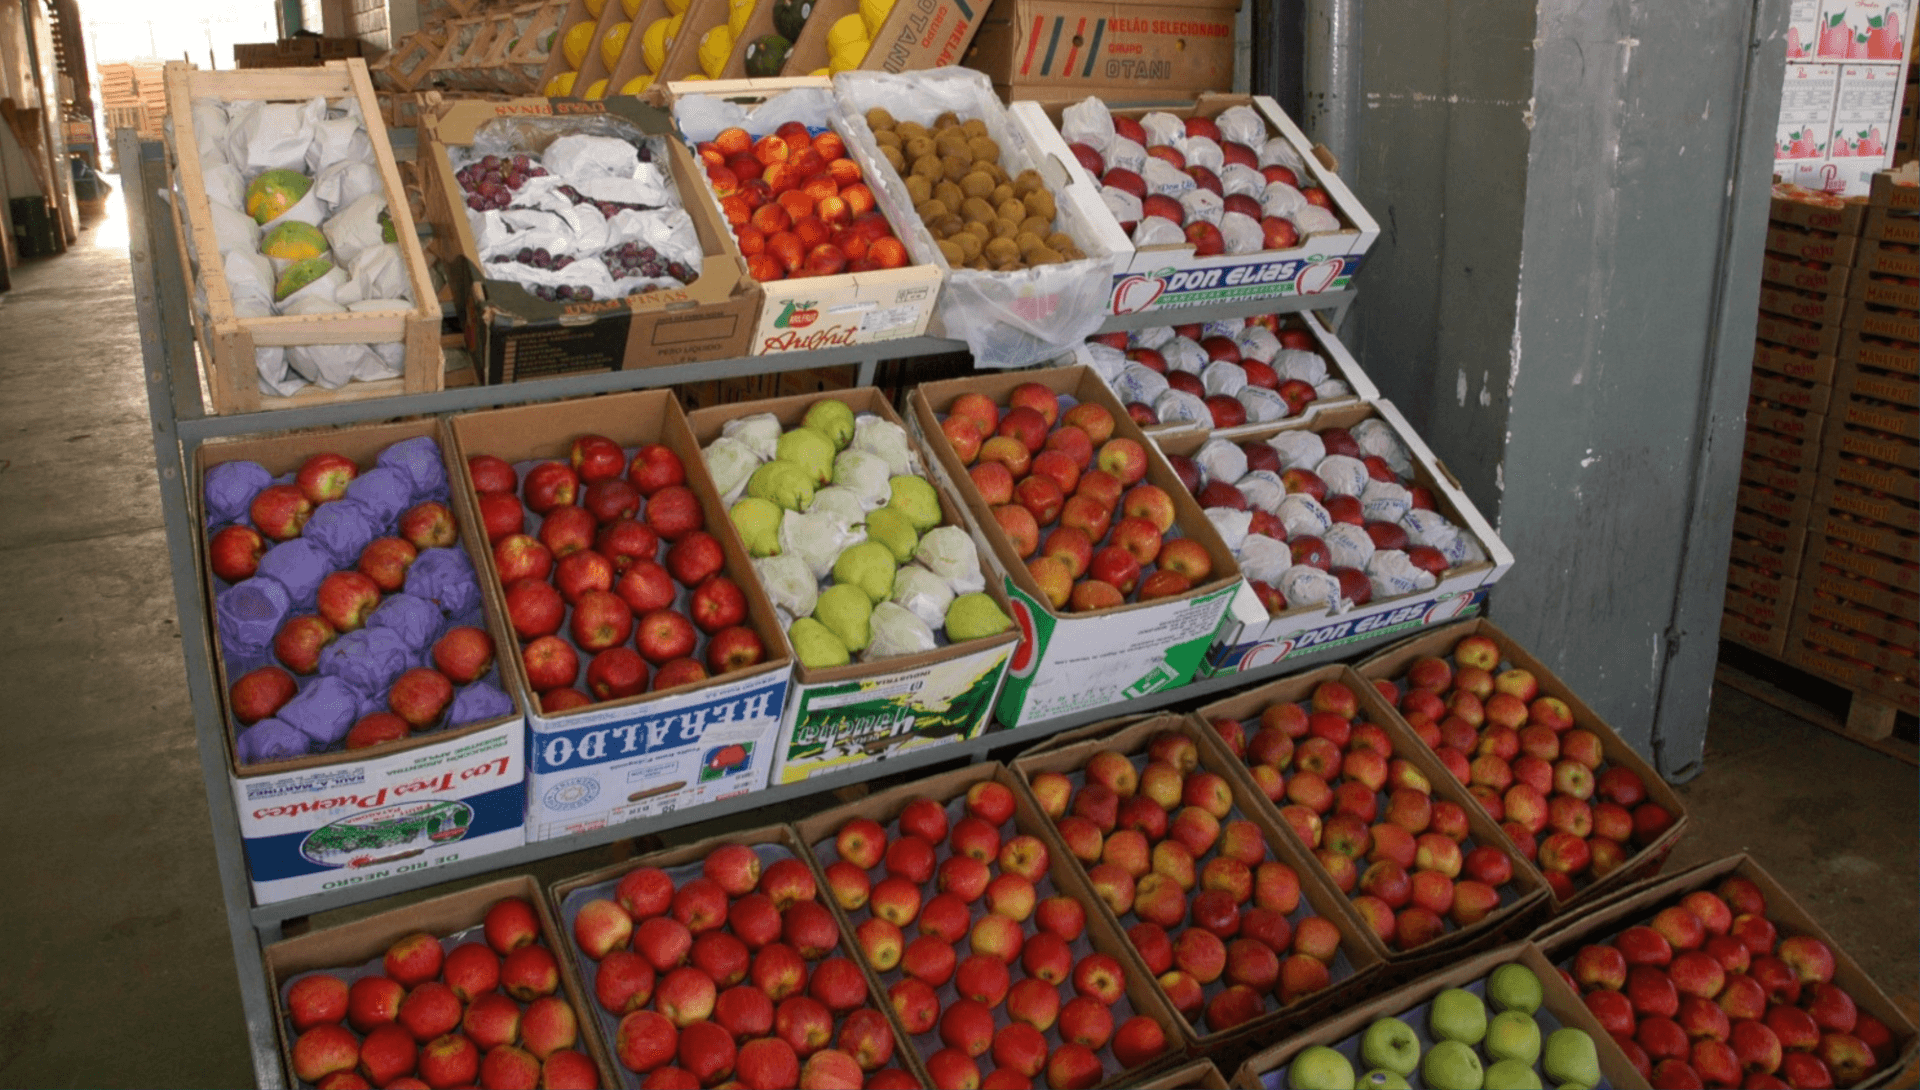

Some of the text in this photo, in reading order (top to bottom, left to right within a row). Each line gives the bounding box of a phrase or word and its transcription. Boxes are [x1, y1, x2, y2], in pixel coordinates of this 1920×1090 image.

[883, 0, 937, 74] OTANI
[920, 6, 949, 49] GRUPO
[1152, 20, 1229, 37] SELECIONADO
[1108, 43, 1143, 54] GRUPO
[1106, 59, 1171, 79] OTANI
[565, 291, 688, 315] UVAS FINAS
[875, 670, 931, 686] INDUSTRIA
[543, 690, 777, 767] HERALDO
[461, 756, 510, 781] Los
[393, 771, 456, 796] Tres
[252, 787, 389, 820] Puentes
[435, 853, 460, 864] DE
[321, 869, 390, 889] NEGRO
